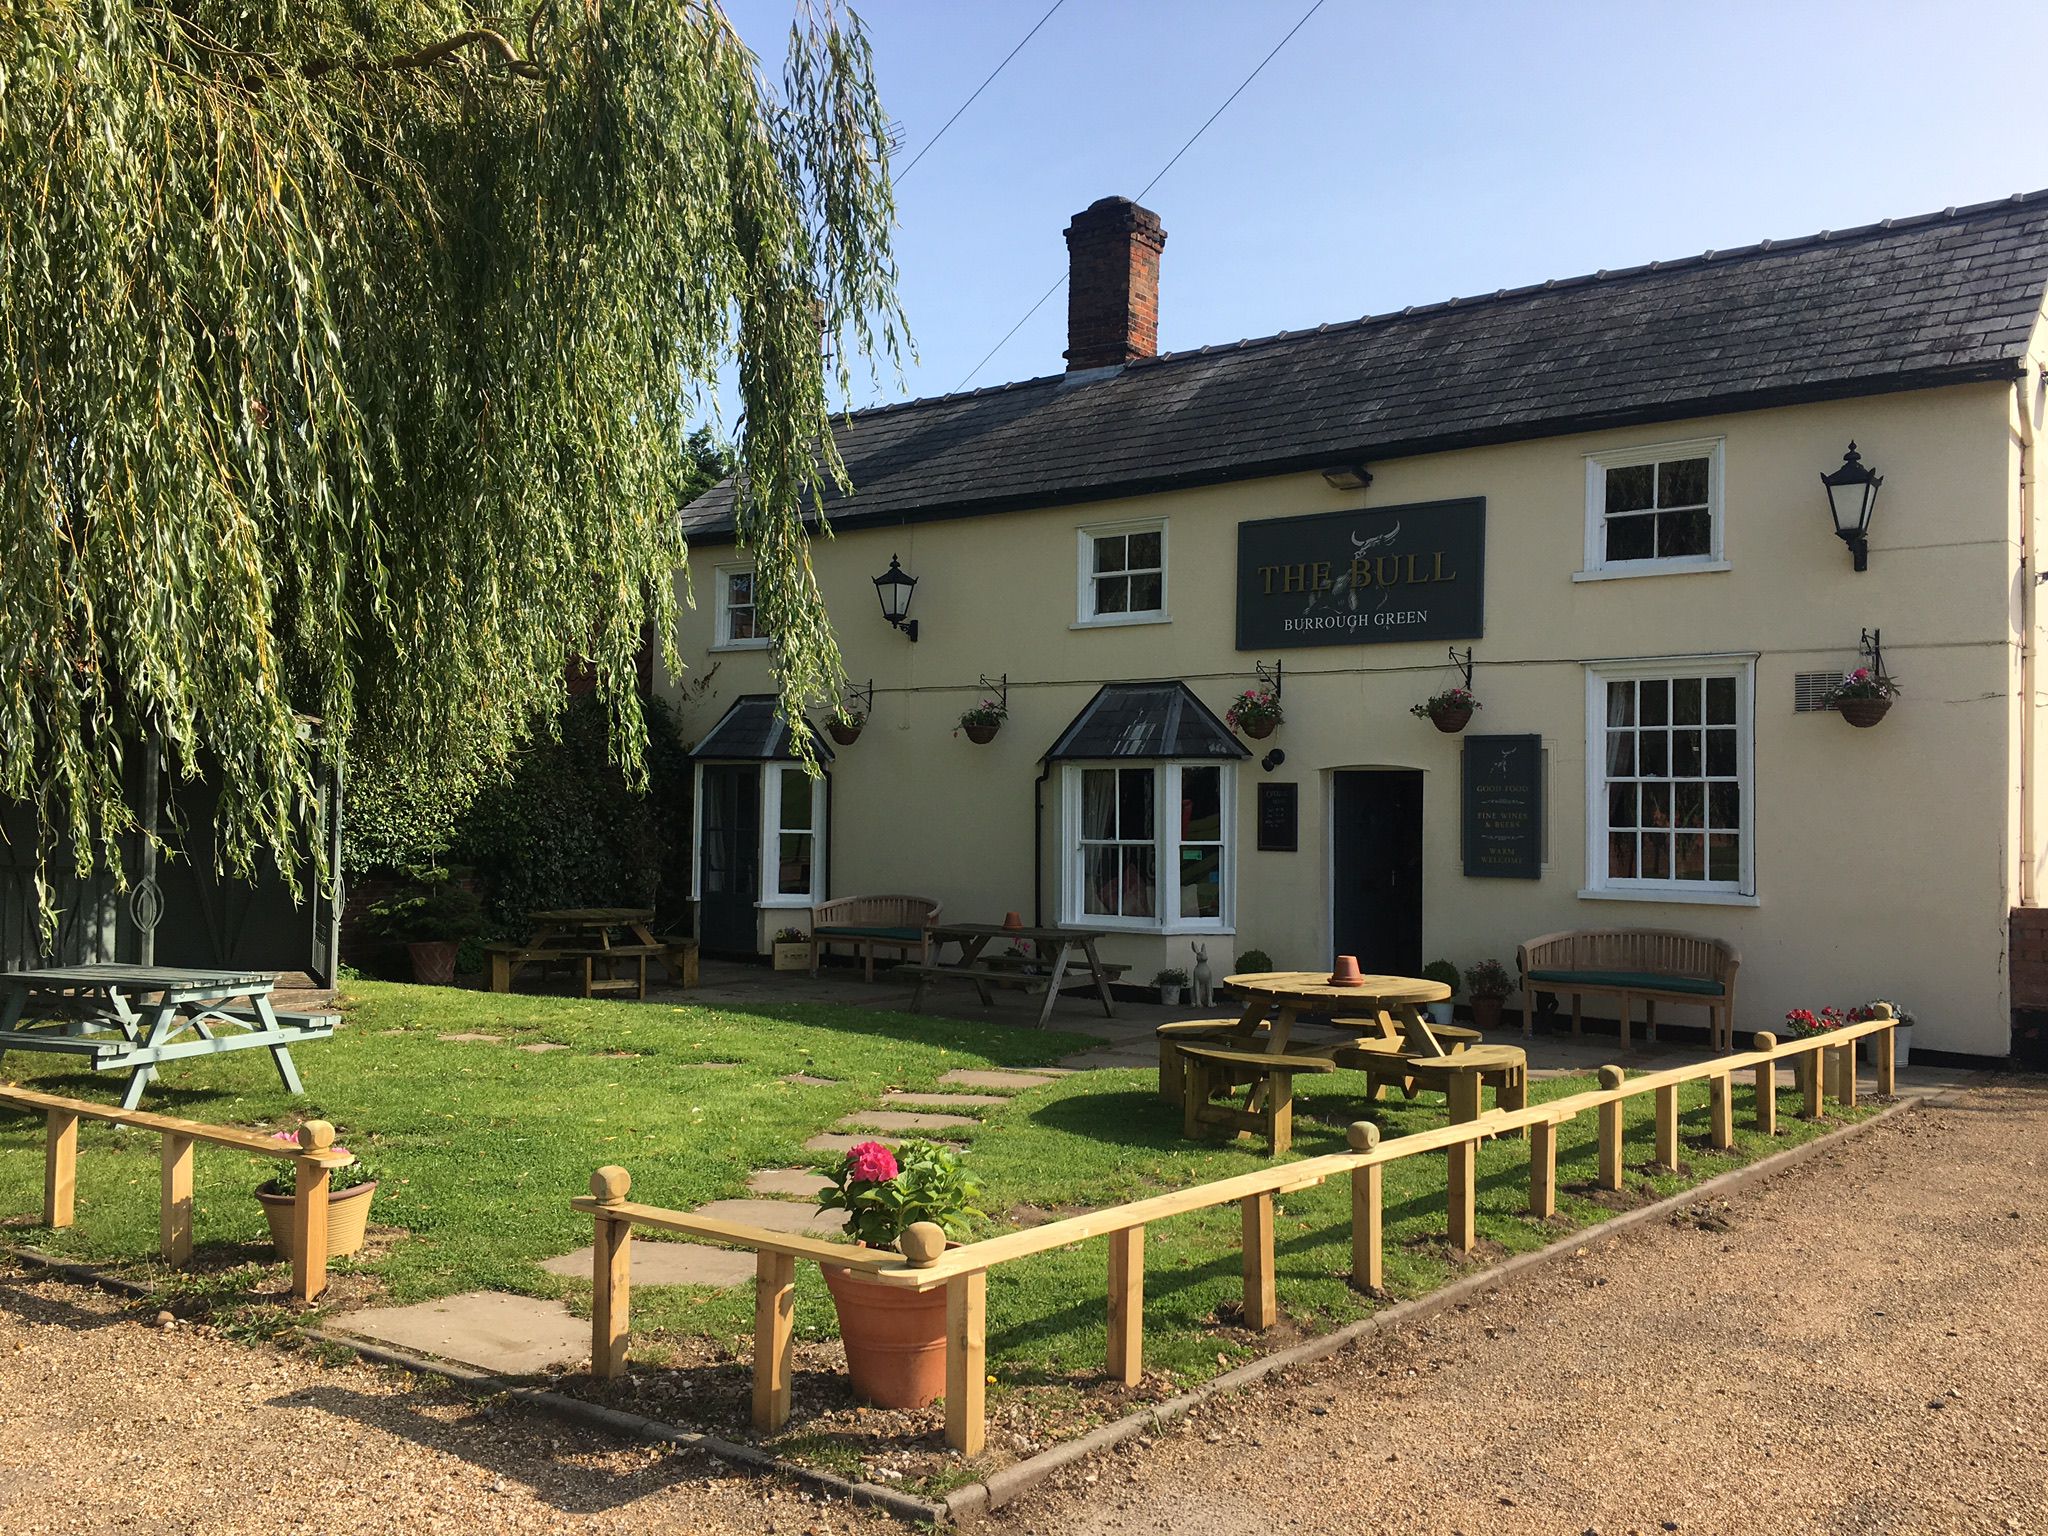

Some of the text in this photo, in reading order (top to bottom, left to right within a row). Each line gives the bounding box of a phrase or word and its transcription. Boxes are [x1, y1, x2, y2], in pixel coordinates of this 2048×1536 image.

[1258, 551, 1456, 595] THE BULL
[1284, 610, 1428, 631] BURROUGH GREEN
[1476, 784, 1528, 792] GOOD FOOD
[1477, 812, 1497, 820] FINE
